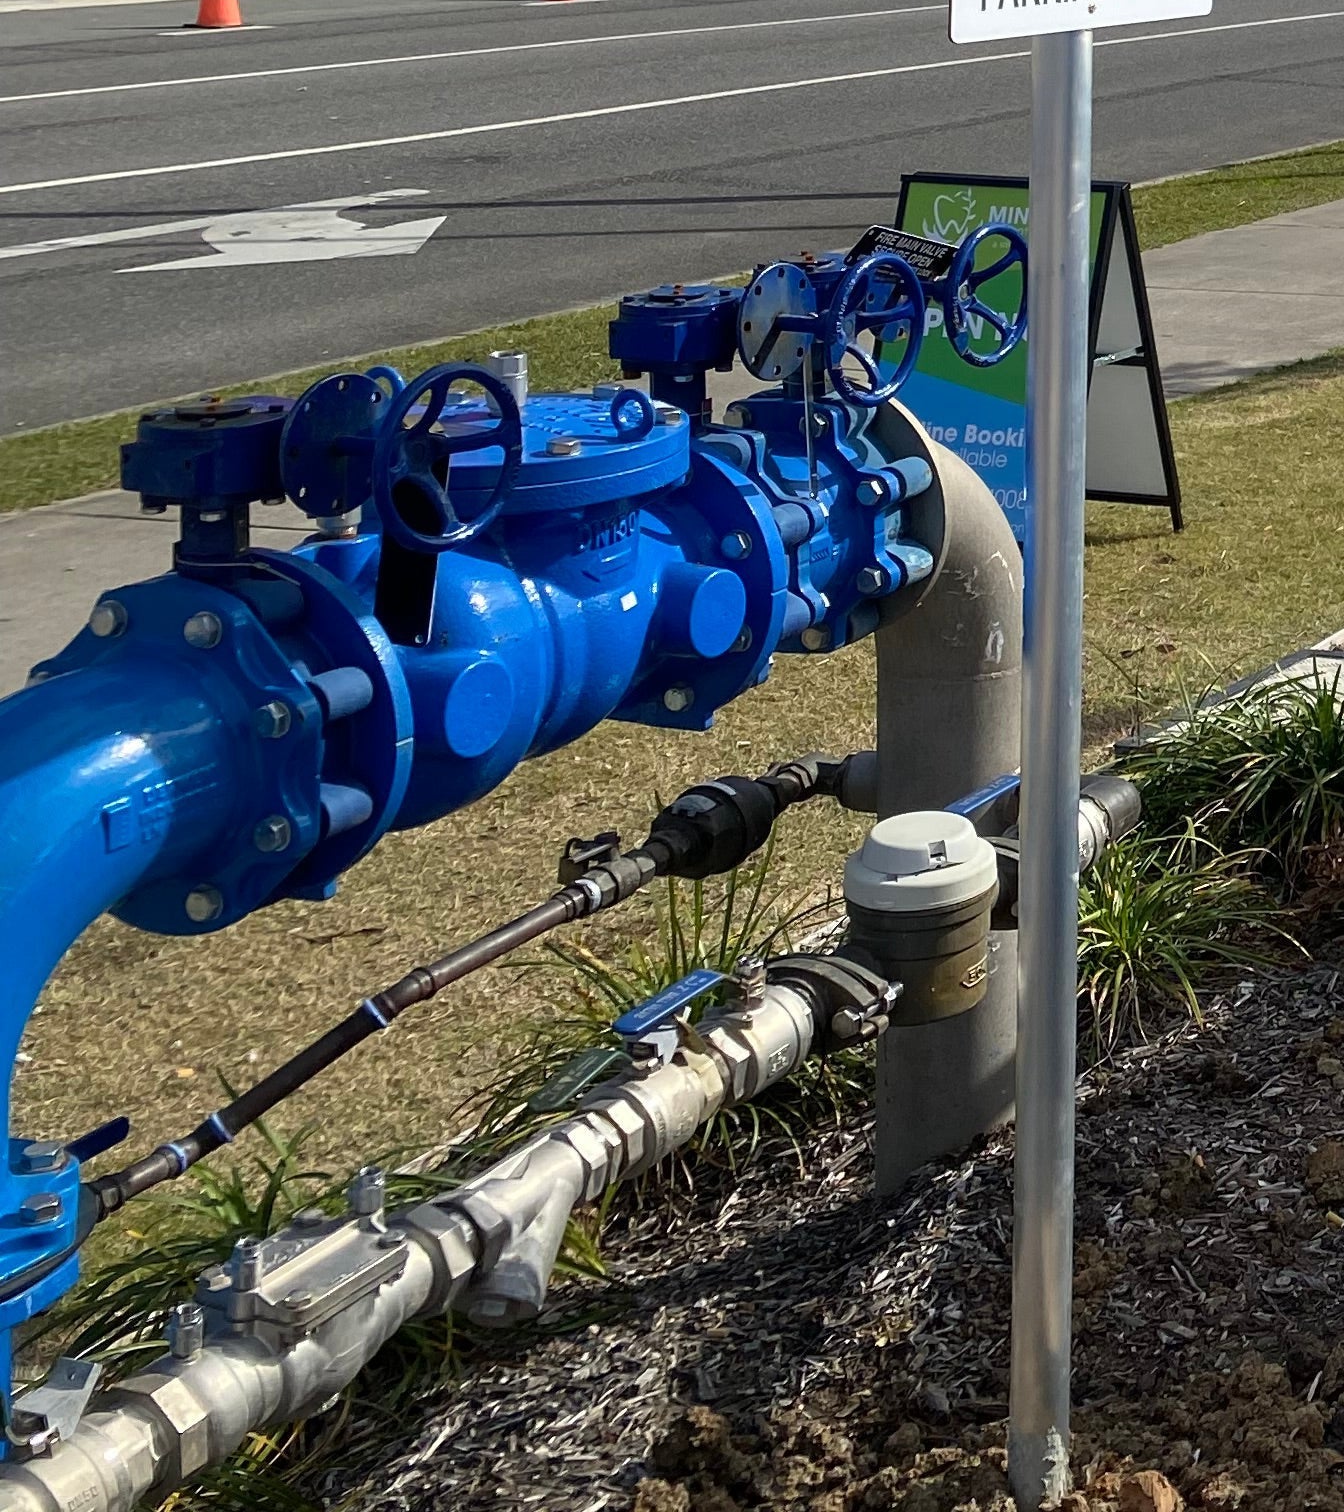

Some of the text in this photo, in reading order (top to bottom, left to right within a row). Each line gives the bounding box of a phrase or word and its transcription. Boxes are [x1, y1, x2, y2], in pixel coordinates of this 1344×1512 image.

[989, 206, 1029, 225] MIN
[875, 232, 948, 258] FIRE MAIN VALVE
[907, 254, 934, 268] OPEN
[964, 424, 1025, 448] Booki
